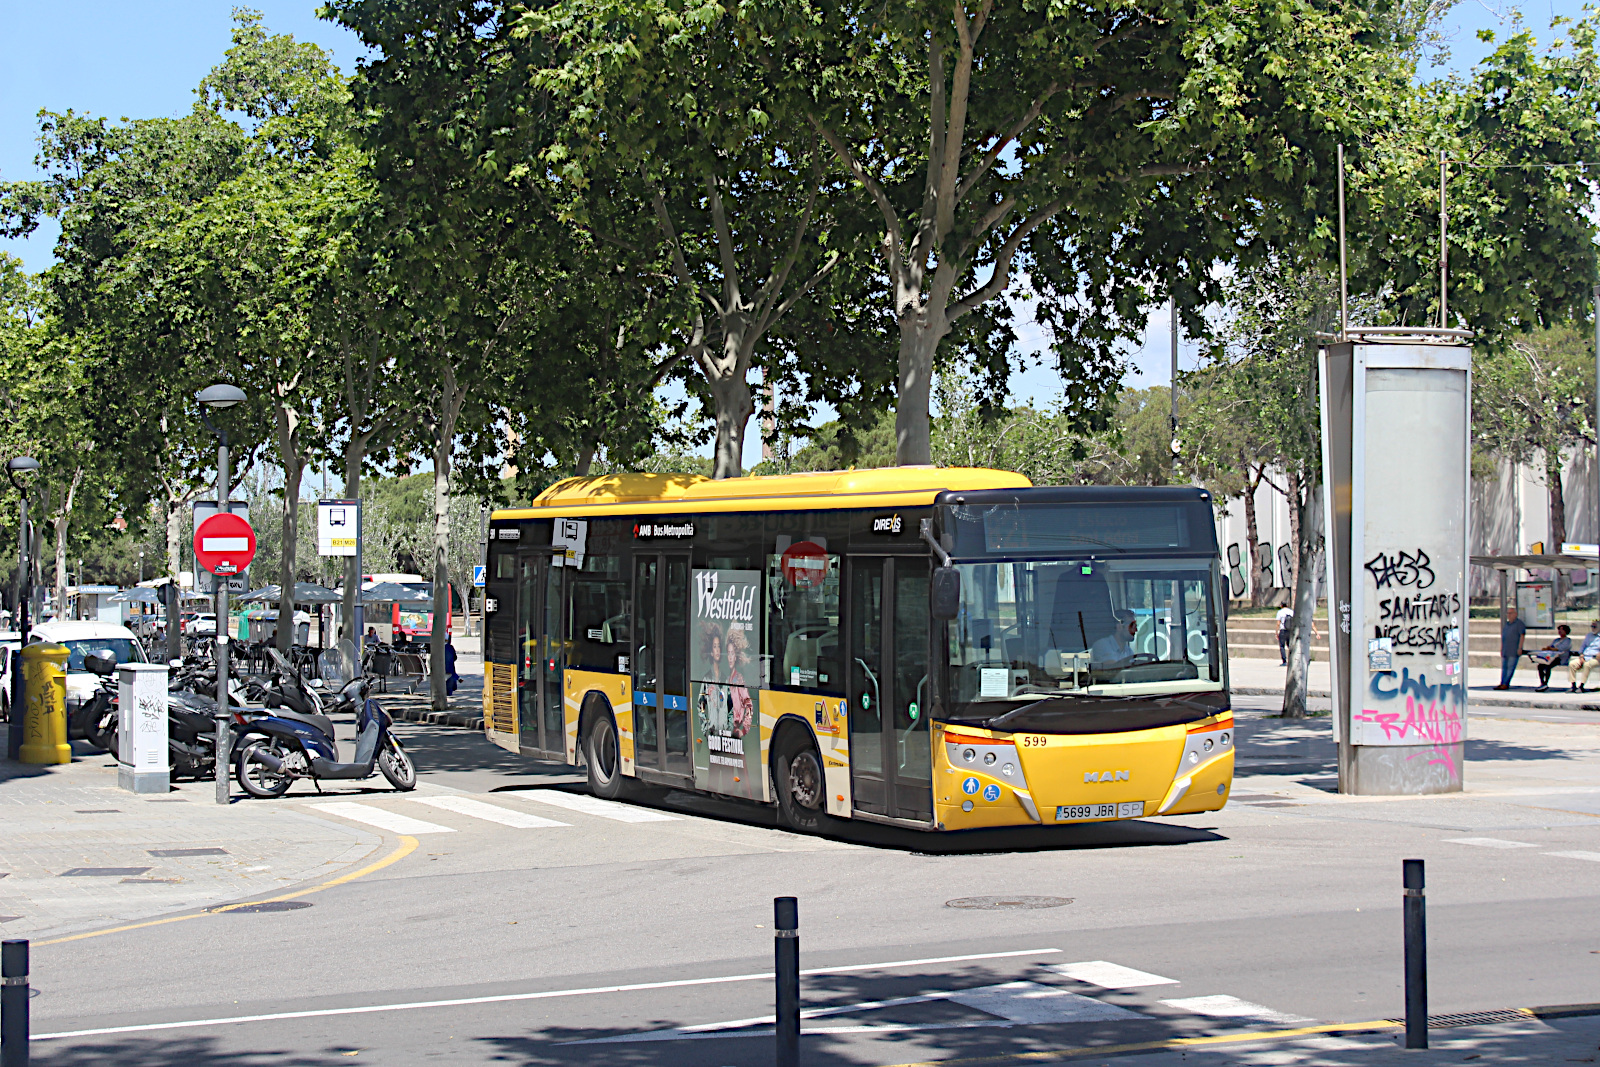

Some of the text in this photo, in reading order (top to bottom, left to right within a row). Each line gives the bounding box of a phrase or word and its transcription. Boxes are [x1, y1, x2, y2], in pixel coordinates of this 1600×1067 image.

[639, 522, 694, 539] AMB Bus Metropolità
[874, 514, 901, 531] DIREXIS
[695, 571, 757, 621] Westfield
[1023, 736, 1047, 748] 599
[1083, 770, 1130, 783] MAN
[1063, 803, 1140, 819] 5699 JBR SP
